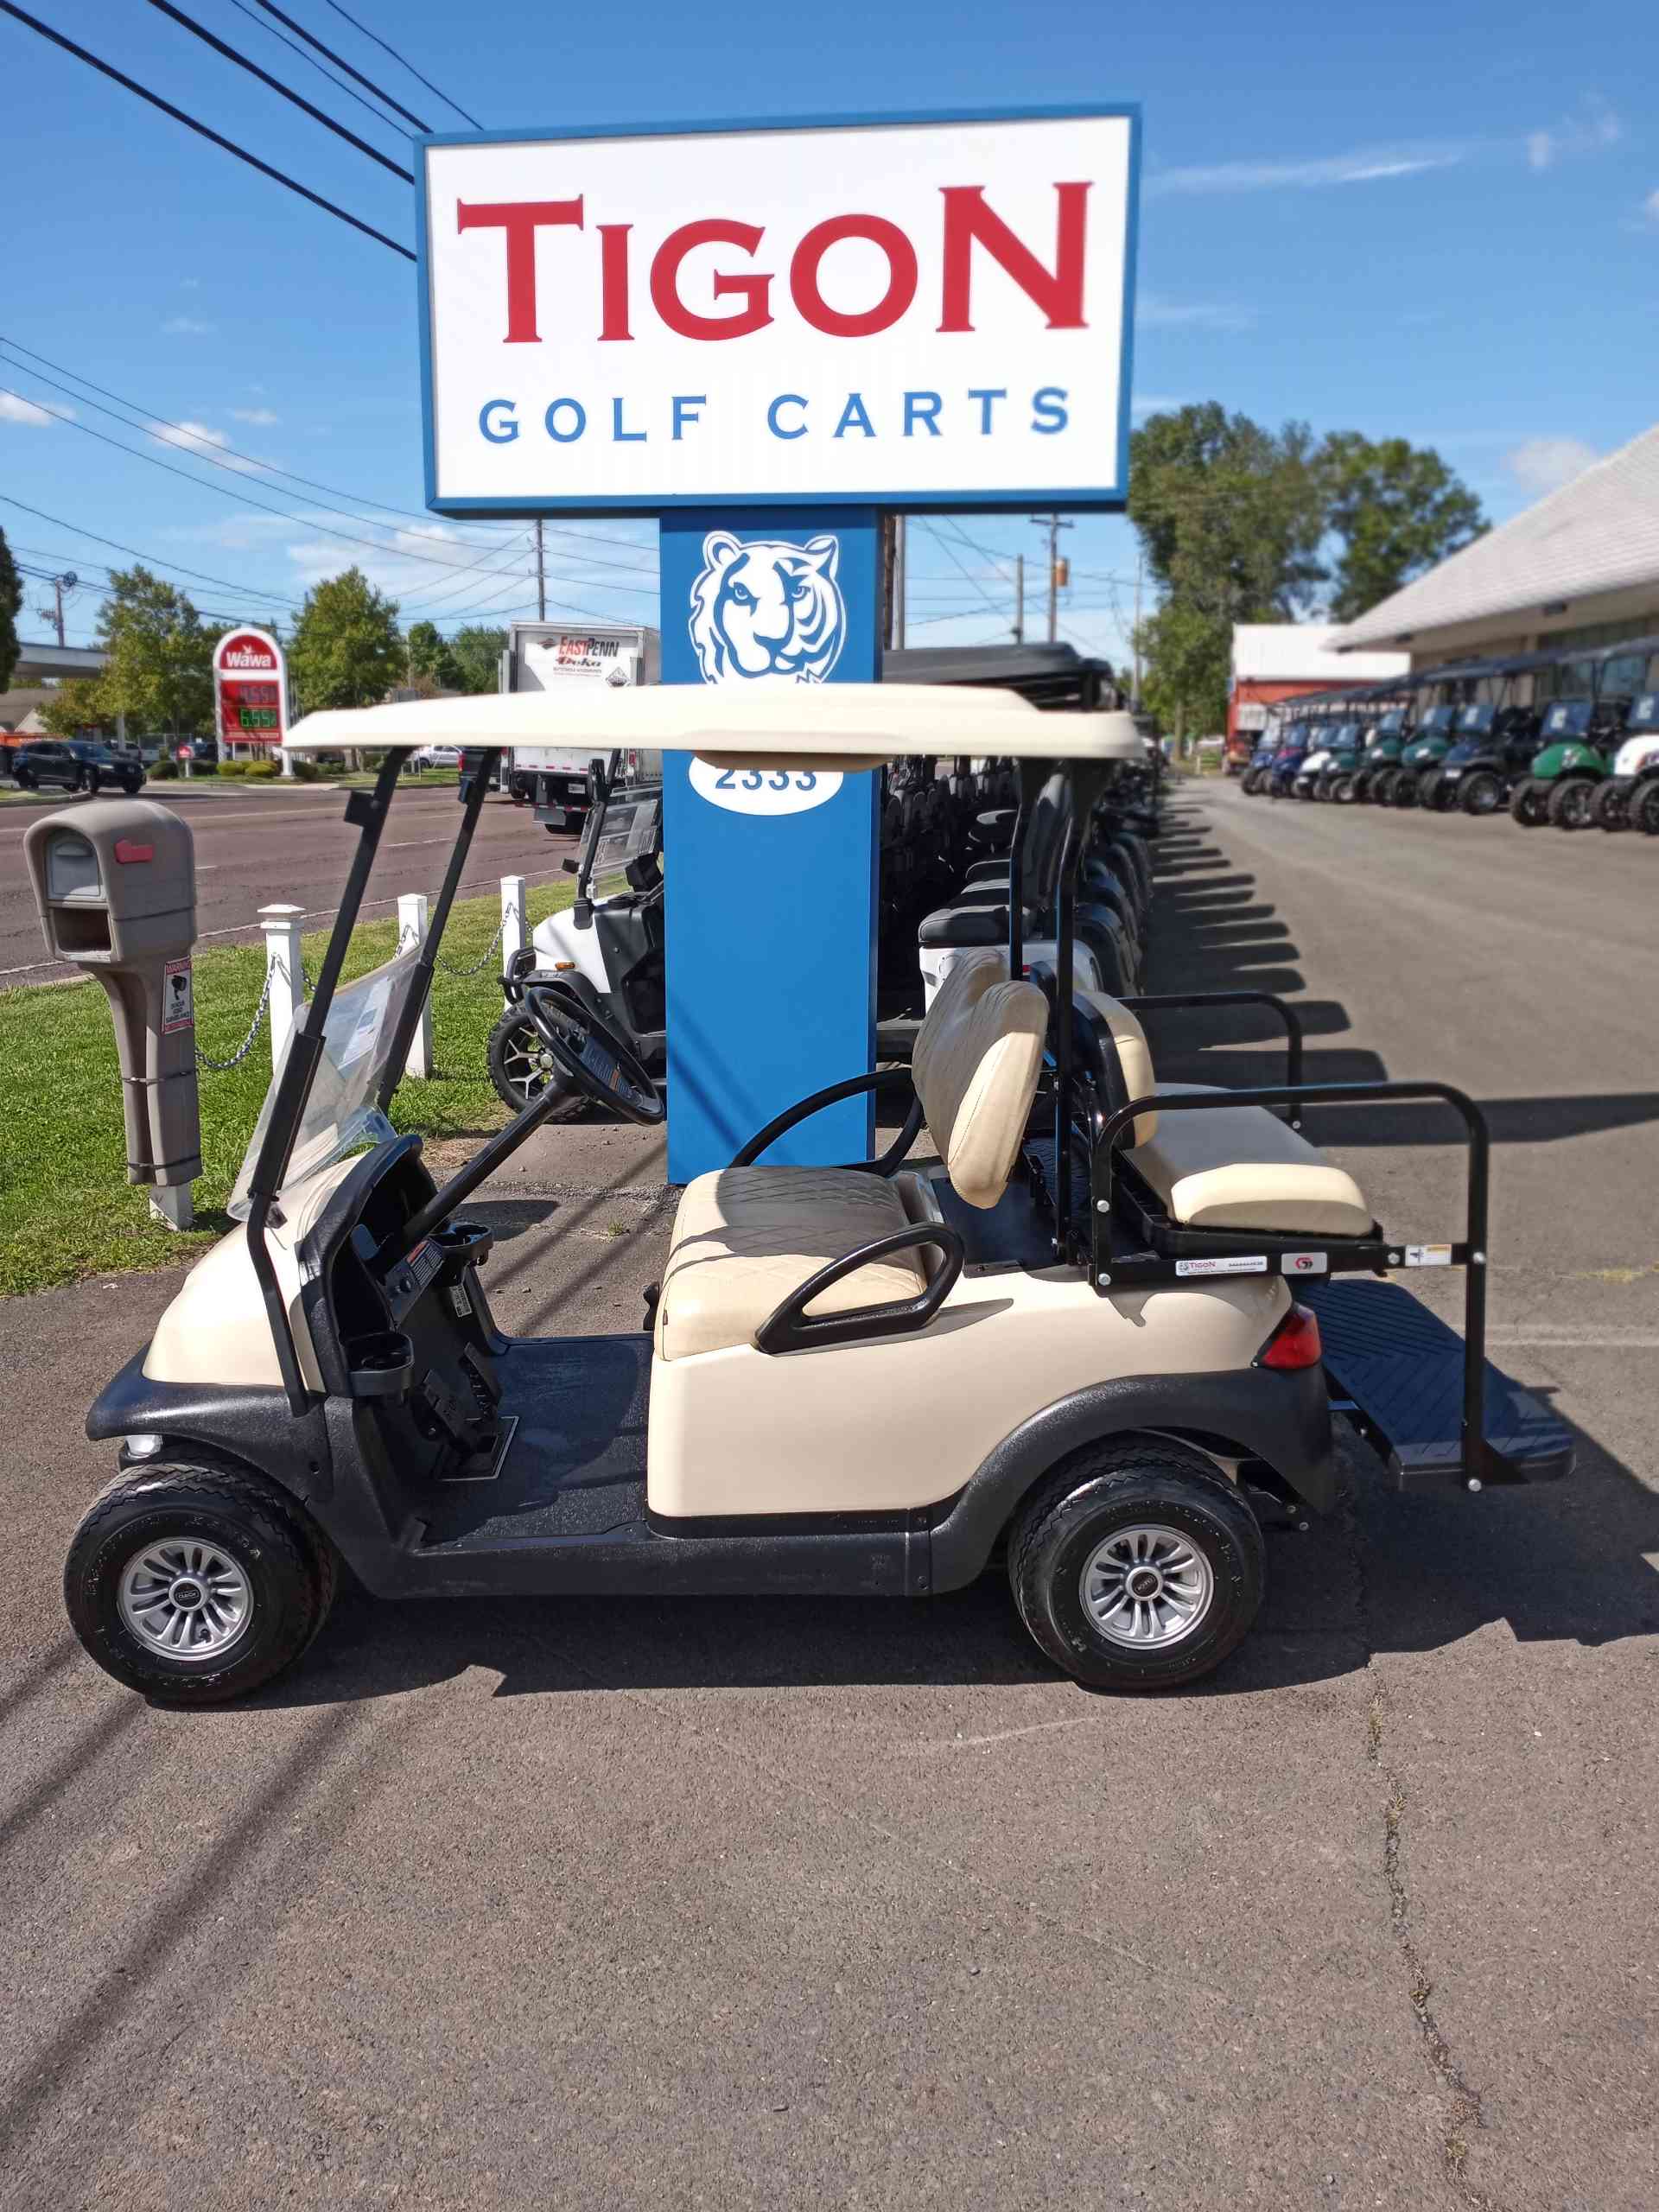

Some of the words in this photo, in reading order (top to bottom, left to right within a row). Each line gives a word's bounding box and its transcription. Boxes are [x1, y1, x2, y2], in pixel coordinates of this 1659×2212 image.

[458, 181, 1093, 343] TIGON
[479, 395, 707, 444] GOLF
[767, 386, 1070, 440] CARTS
[226, 652, 270, 667] Wawa
[715, 768, 817, 791] 2333
